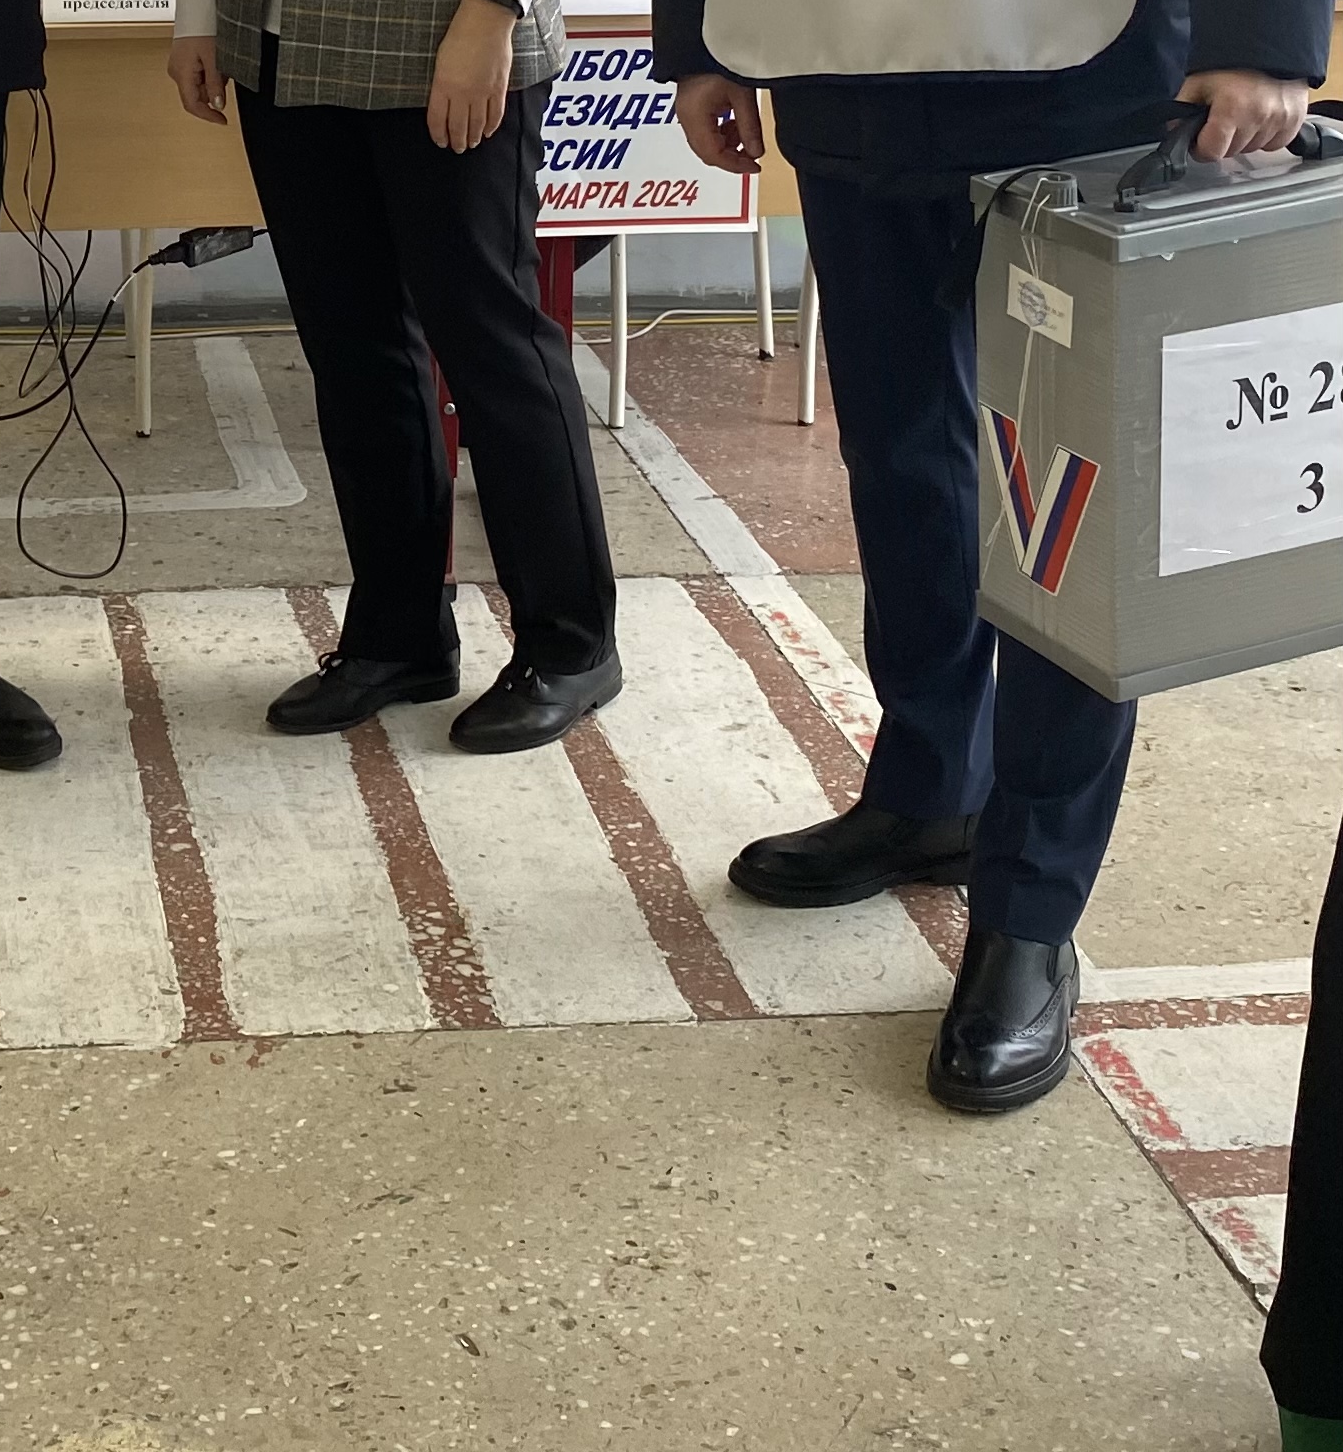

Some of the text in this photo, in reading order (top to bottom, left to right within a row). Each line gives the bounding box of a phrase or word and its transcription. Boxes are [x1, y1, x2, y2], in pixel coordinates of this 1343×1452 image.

[63, 0, 169, 12] председателя
[543, 93, 680, 130] ЕЗИДЕ
[539, 179, 699, 210] МАРТА 2024
[1226, 361, 1343, 430] № 2
[1296, 462, 1325, 513] 3
